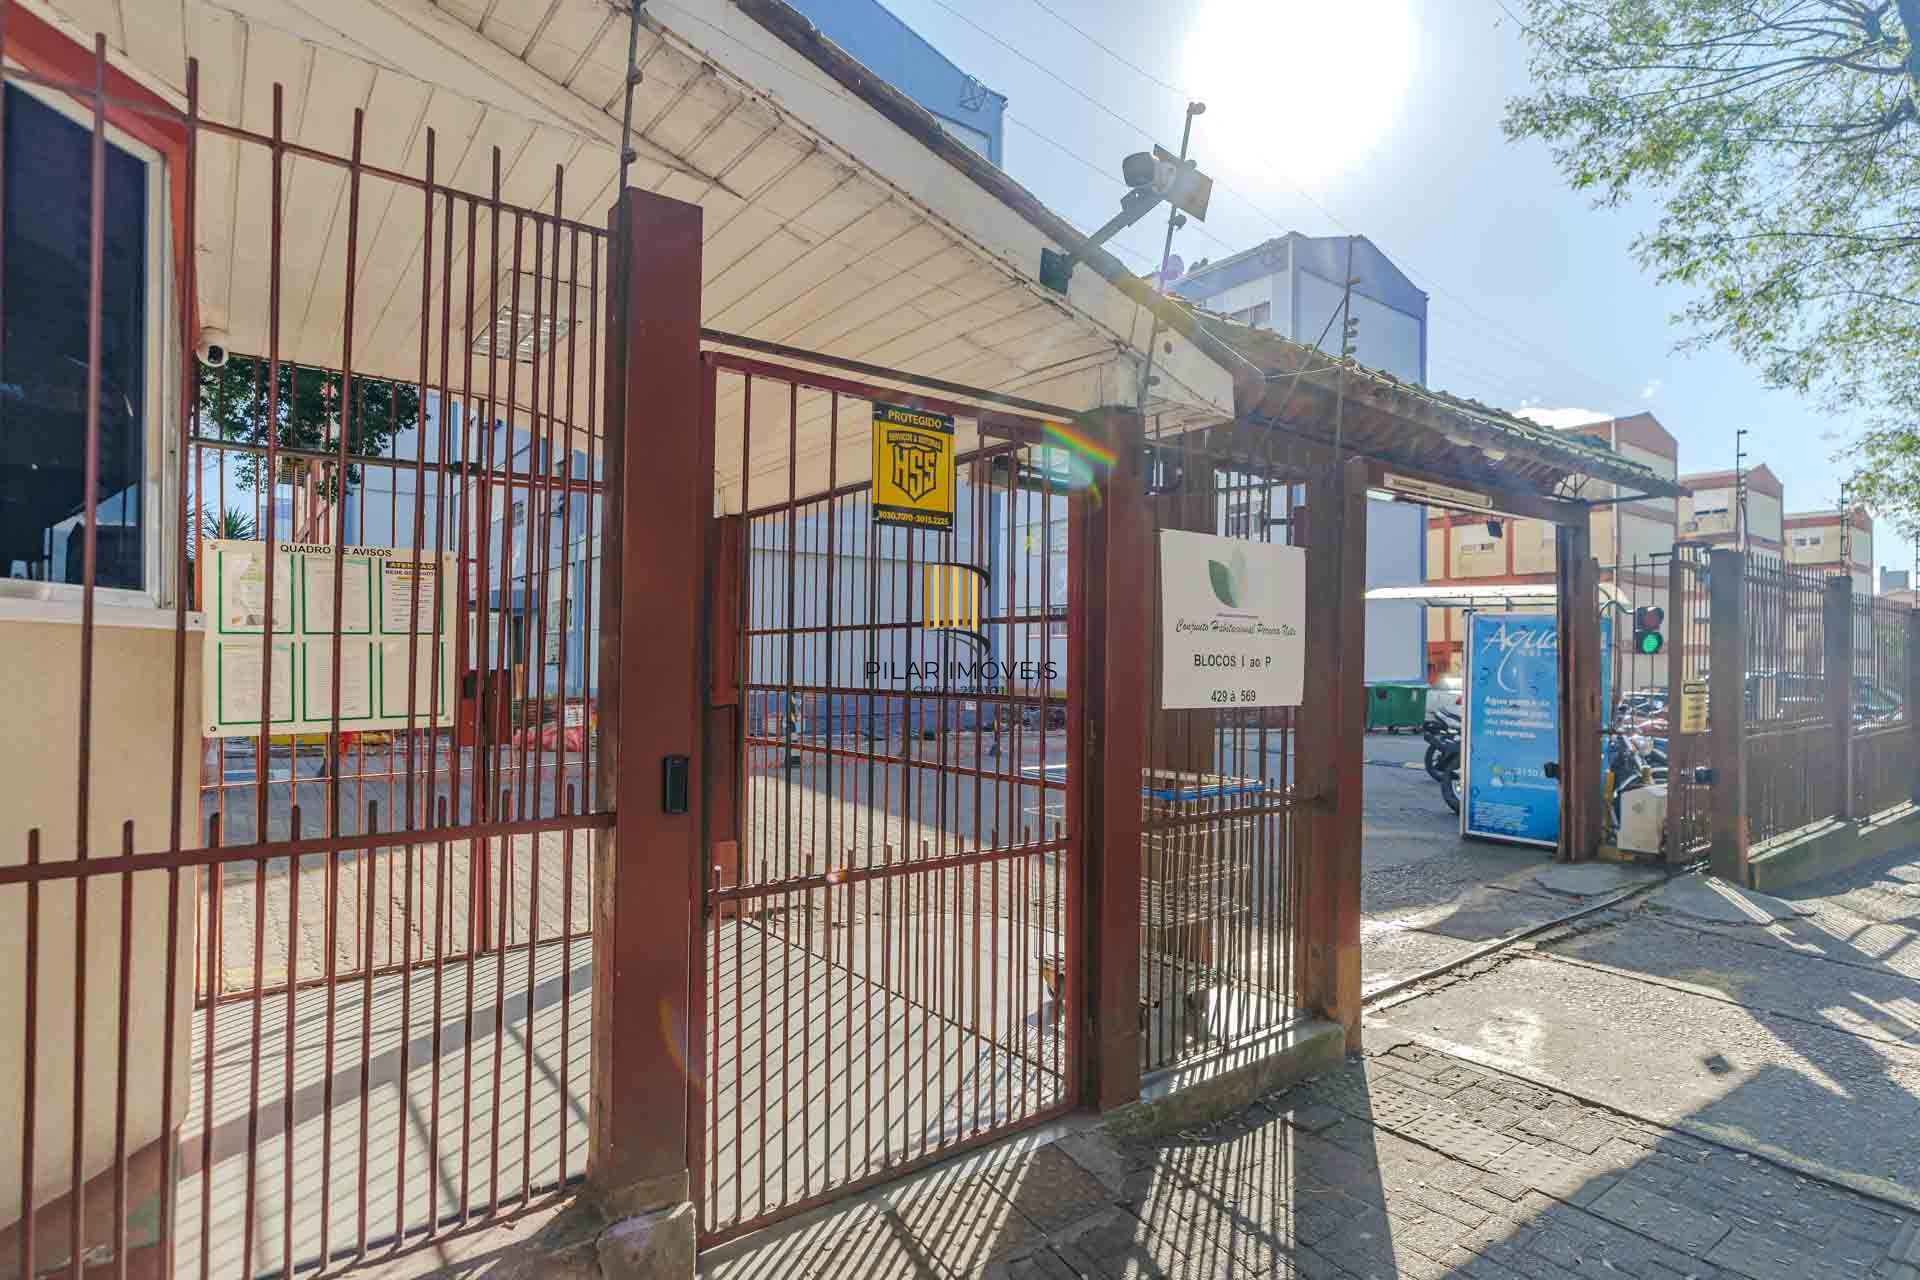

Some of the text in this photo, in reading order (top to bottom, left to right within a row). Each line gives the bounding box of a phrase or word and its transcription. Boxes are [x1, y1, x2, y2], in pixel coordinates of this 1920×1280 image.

[888, 409, 942, 429] PROTEGIDO
[893, 445, 936, 501] HSS
[280, 545, 331, 555] QUADRO
[353, 548, 392, 557] AVISOS
[1176, 616, 1209, 634] Conjunto
[1193, 654, 1236, 667] BLOCOS
[1250, 658, 1261, 667] ao
[1265, 656, 1272, 668] P
[1211, 690, 1228, 702] 429
[1240, 690, 1256, 702] 569
